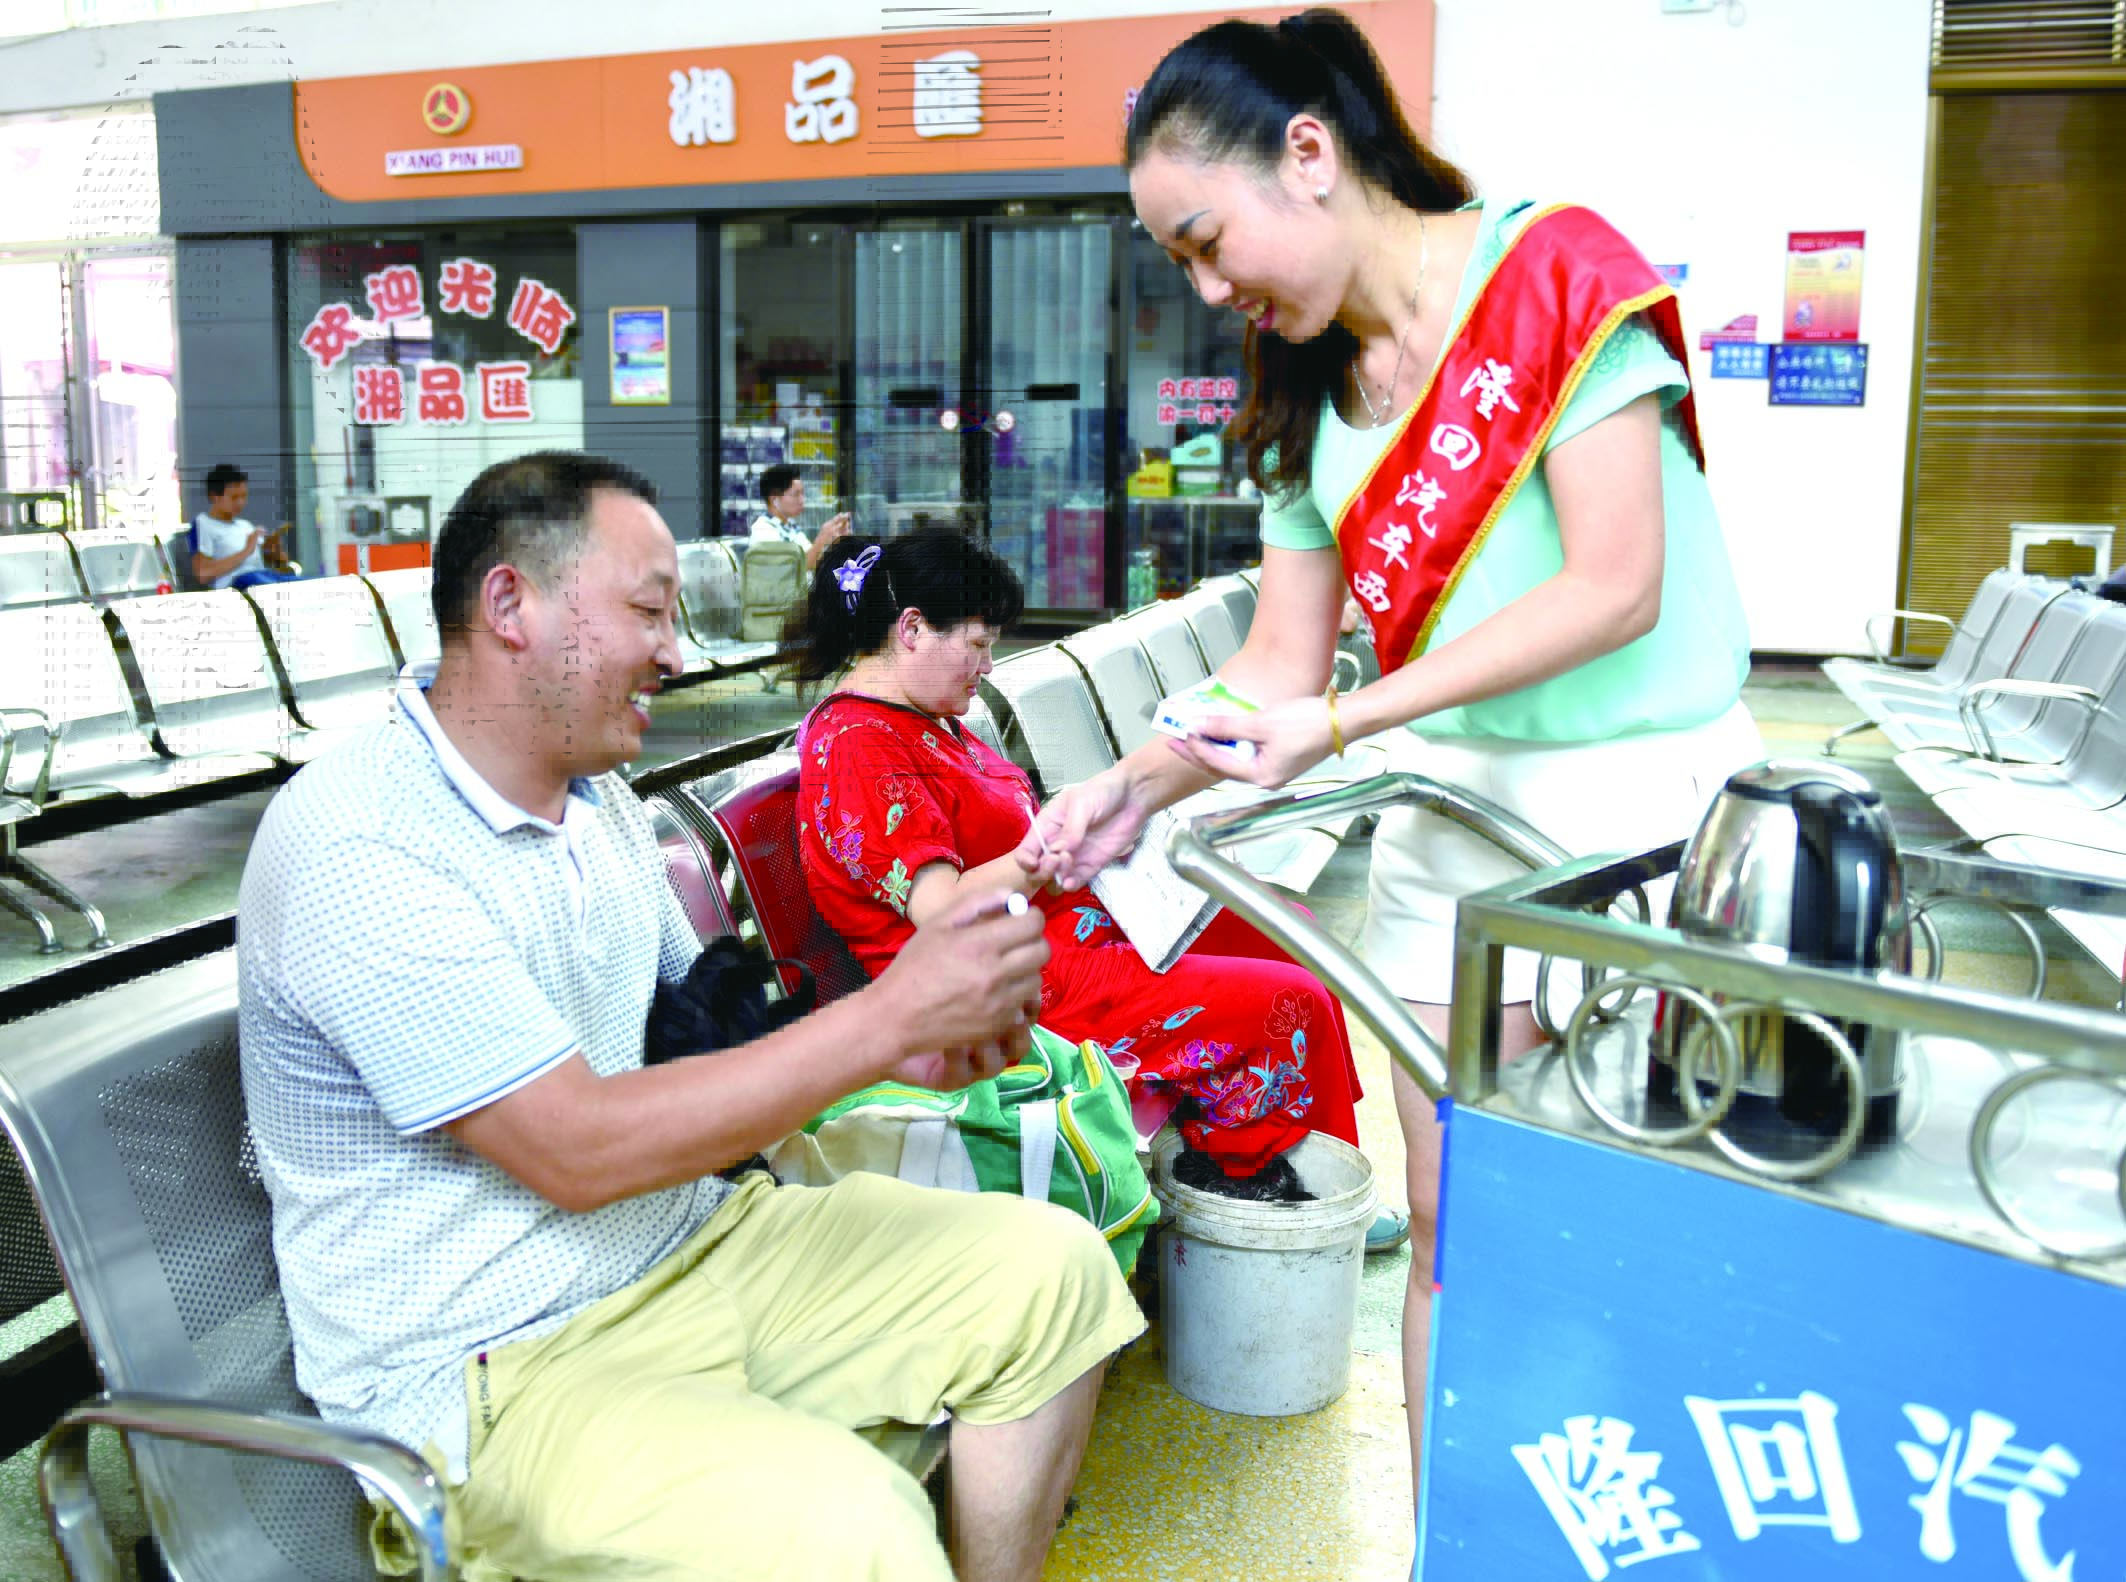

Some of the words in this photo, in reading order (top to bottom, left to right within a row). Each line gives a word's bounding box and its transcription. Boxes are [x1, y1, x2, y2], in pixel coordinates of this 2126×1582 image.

[449, 151, 477, 167] PIN
[484, 149, 516, 165] HUI
[301, 257, 576, 369] 欢迎光临
[353, 361, 536, 425] 湘品匯
[1157, 377, 1238, 401] 内有监控
[1157, 402, 1235, 425] 偷一罚十
[1354, 357, 1520, 643] 隆回汽车西
[1510, 1389, 2083, 1582] 隆回汽
